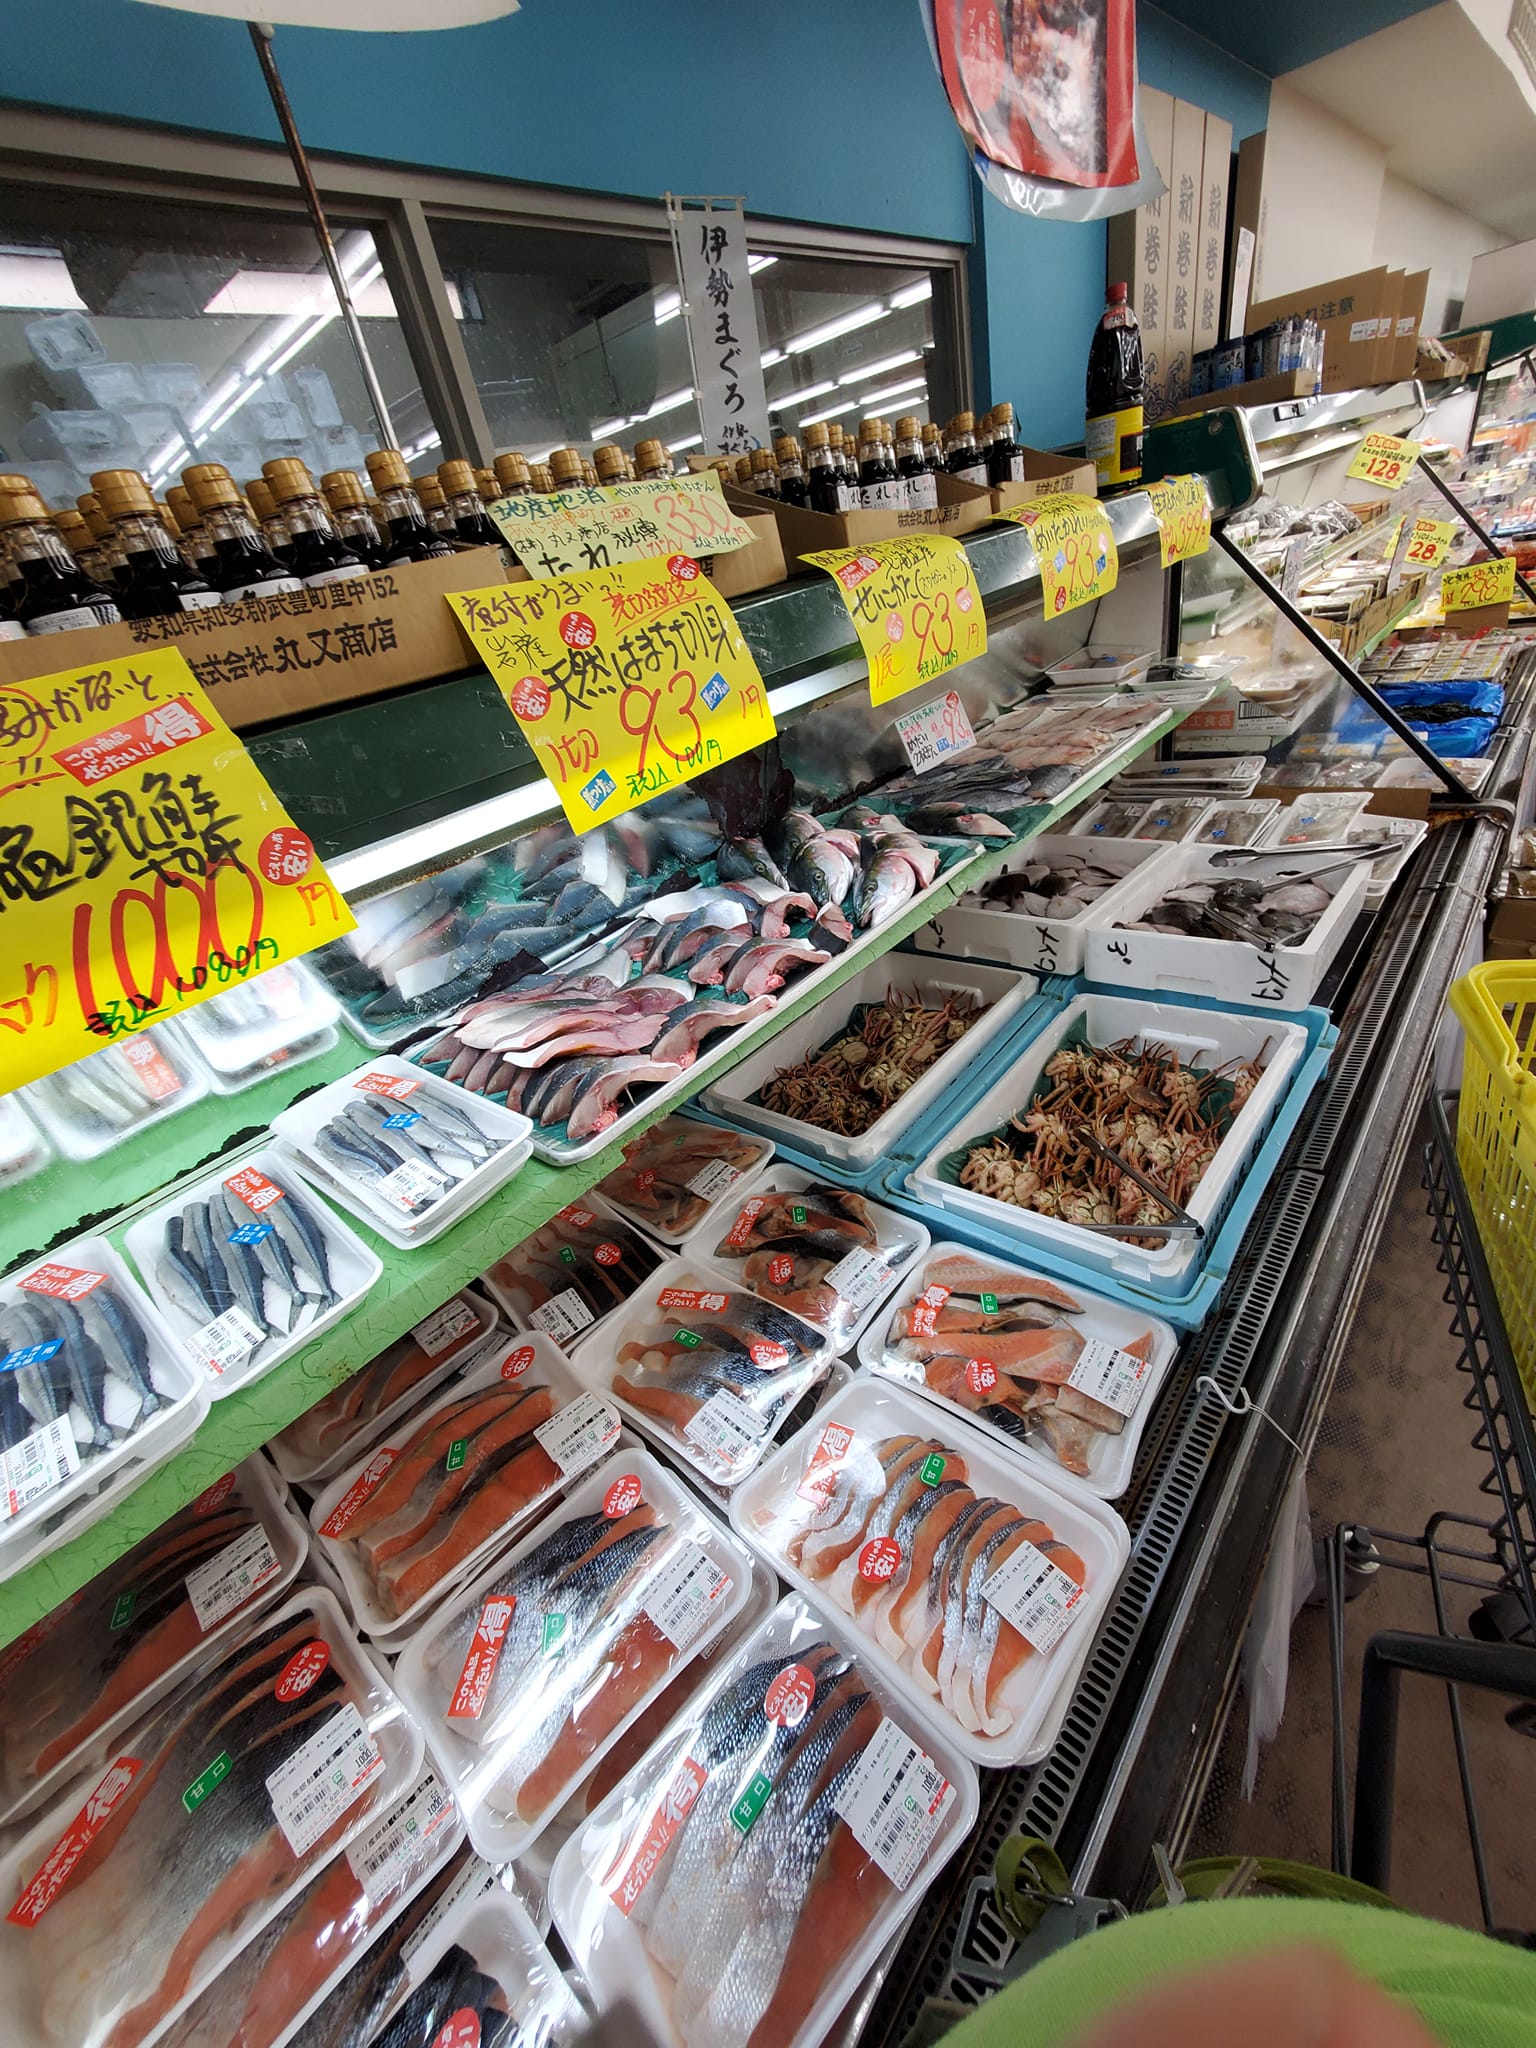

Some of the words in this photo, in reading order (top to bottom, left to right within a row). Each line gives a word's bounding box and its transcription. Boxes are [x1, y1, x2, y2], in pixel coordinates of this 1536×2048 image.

[1173, 174, 1194, 330] 新巻鮭
[1201, 184, 1221, 330] 新巻鮭
[700, 224, 745, 414] 伊勢まぐろ
[1366, 457, 1400, 480] 128
[494, 486, 607, 521] 地産地消
[654, 493, 732, 541] 330
[1065, 533, 1095, 592] 93
[128, 574, 399, 643] 愛知県知多郡武豊町里中152
[574, 621, 593, 647] 安い
[912, 591, 954, 673] 93
[967, 623, 979, 651] 円
[542, 602, 737, 725] 天然はまち切身
[527, 687, 548, 718] 安い
[738, 684, 765, 719] 円
[145, 702, 202, 748] 得
[619, 669, 702, 779] 93
[943, 708, 966, 745] 93
[65, 731, 133, 767] この商品
[82, 742, 156, 780] ぜったい!!
[130, 814, 244, 888] 切身
[267, 831, 285, 881] どえりゃあ
[282, 839, 310, 878] 安い
[296, 881, 340, 926] 円
[72, 857, 264, 1036] 1000
[387, 1079, 417, 1097] 得
[247, 1187, 281, 1208] 得
[744, 1199, 765, 1217] 得
[60, 1272, 104, 1300] 得
[780, 1258, 793, 1279] 安い
[698, 1293, 727, 1311] 得
[926, 1286, 951, 1308] 得
[512, 1348, 533, 1373] 安い
[980, 1362, 996, 1389] 安い
[822, 1424, 853, 1459] 得
[363, 1451, 394, 1485] 得
[926, 1458, 941, 1480] 甘口
[618, 1482, 639, 1512] 安い
[874, 1547, 897, 1578] 安い
[478, 1600, 512, 1646] 得
[293, 1652, 325, 1693] 安い
[455, 1652, 480, 1711] この商品
[470, 1646, 499, 1712] ぜったい!!
[781, 1680, 812, 1721] 安い
[354, 1748, 373, 1768] 1000
[84, 1765, 134, 1827] 得
[190, 1762, 227, 1799] 甘口
[661, 1767, 700, 1822] 得
[738, 1780, 767, 1818] 甘口
[920, 1772, 938, 1794] 1000
[426, 1797, 444, 1816] 1000
[18, 1833, 75, 1915] この商品
[31, 1827, 93, 1919] ぜったい!!
[623, 1826, 670, 1905] ぜったい!!
